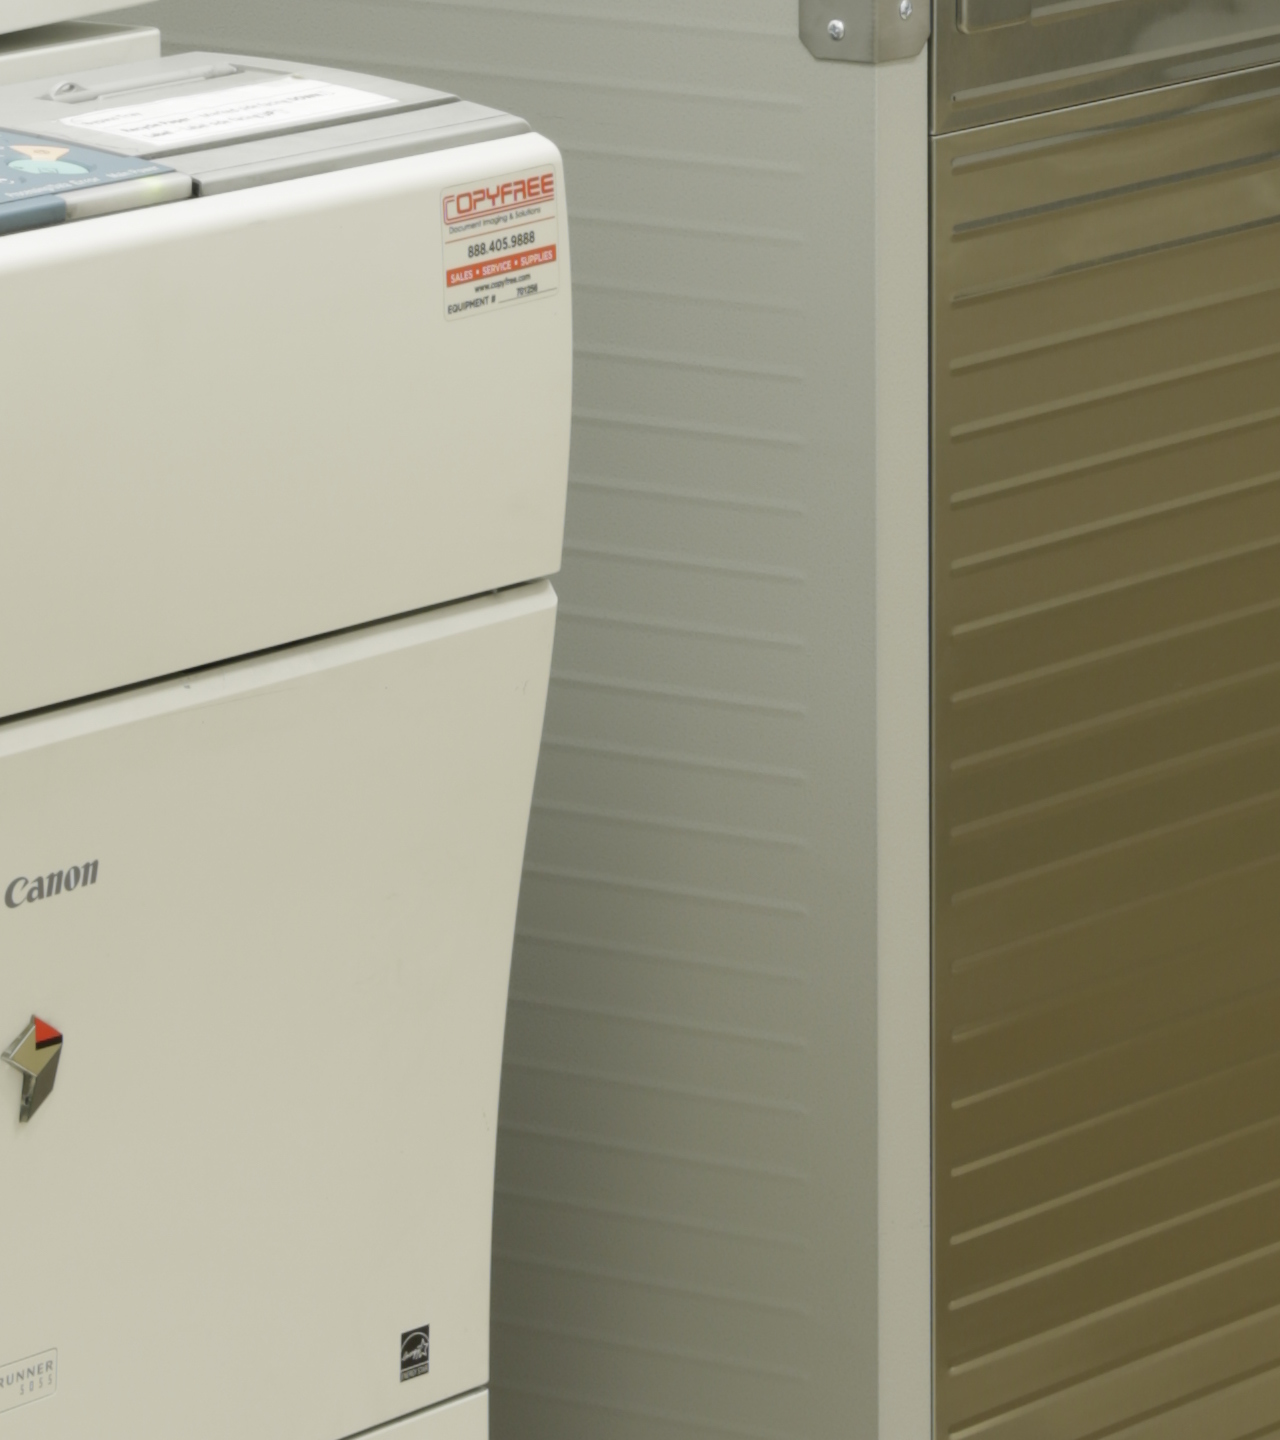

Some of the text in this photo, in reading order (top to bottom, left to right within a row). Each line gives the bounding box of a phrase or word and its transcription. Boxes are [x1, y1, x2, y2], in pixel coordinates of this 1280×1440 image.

[442, 172, 555, 226] COPYFREE
[448, 221, 482, 235] Document
[483, 214, 508, 226] Imaging
[515, 206, 541, 219] Solutions
[467, 230, 535, 258] 888.405.9888
[450, 250, 553, 284] SALES SERVICE SUPPLIES
[474, 273, 531, 293] www.copyfree.com
[447, 295, 489, 315] EQUIPMENT
[4, 859, 99, 909] Canon
